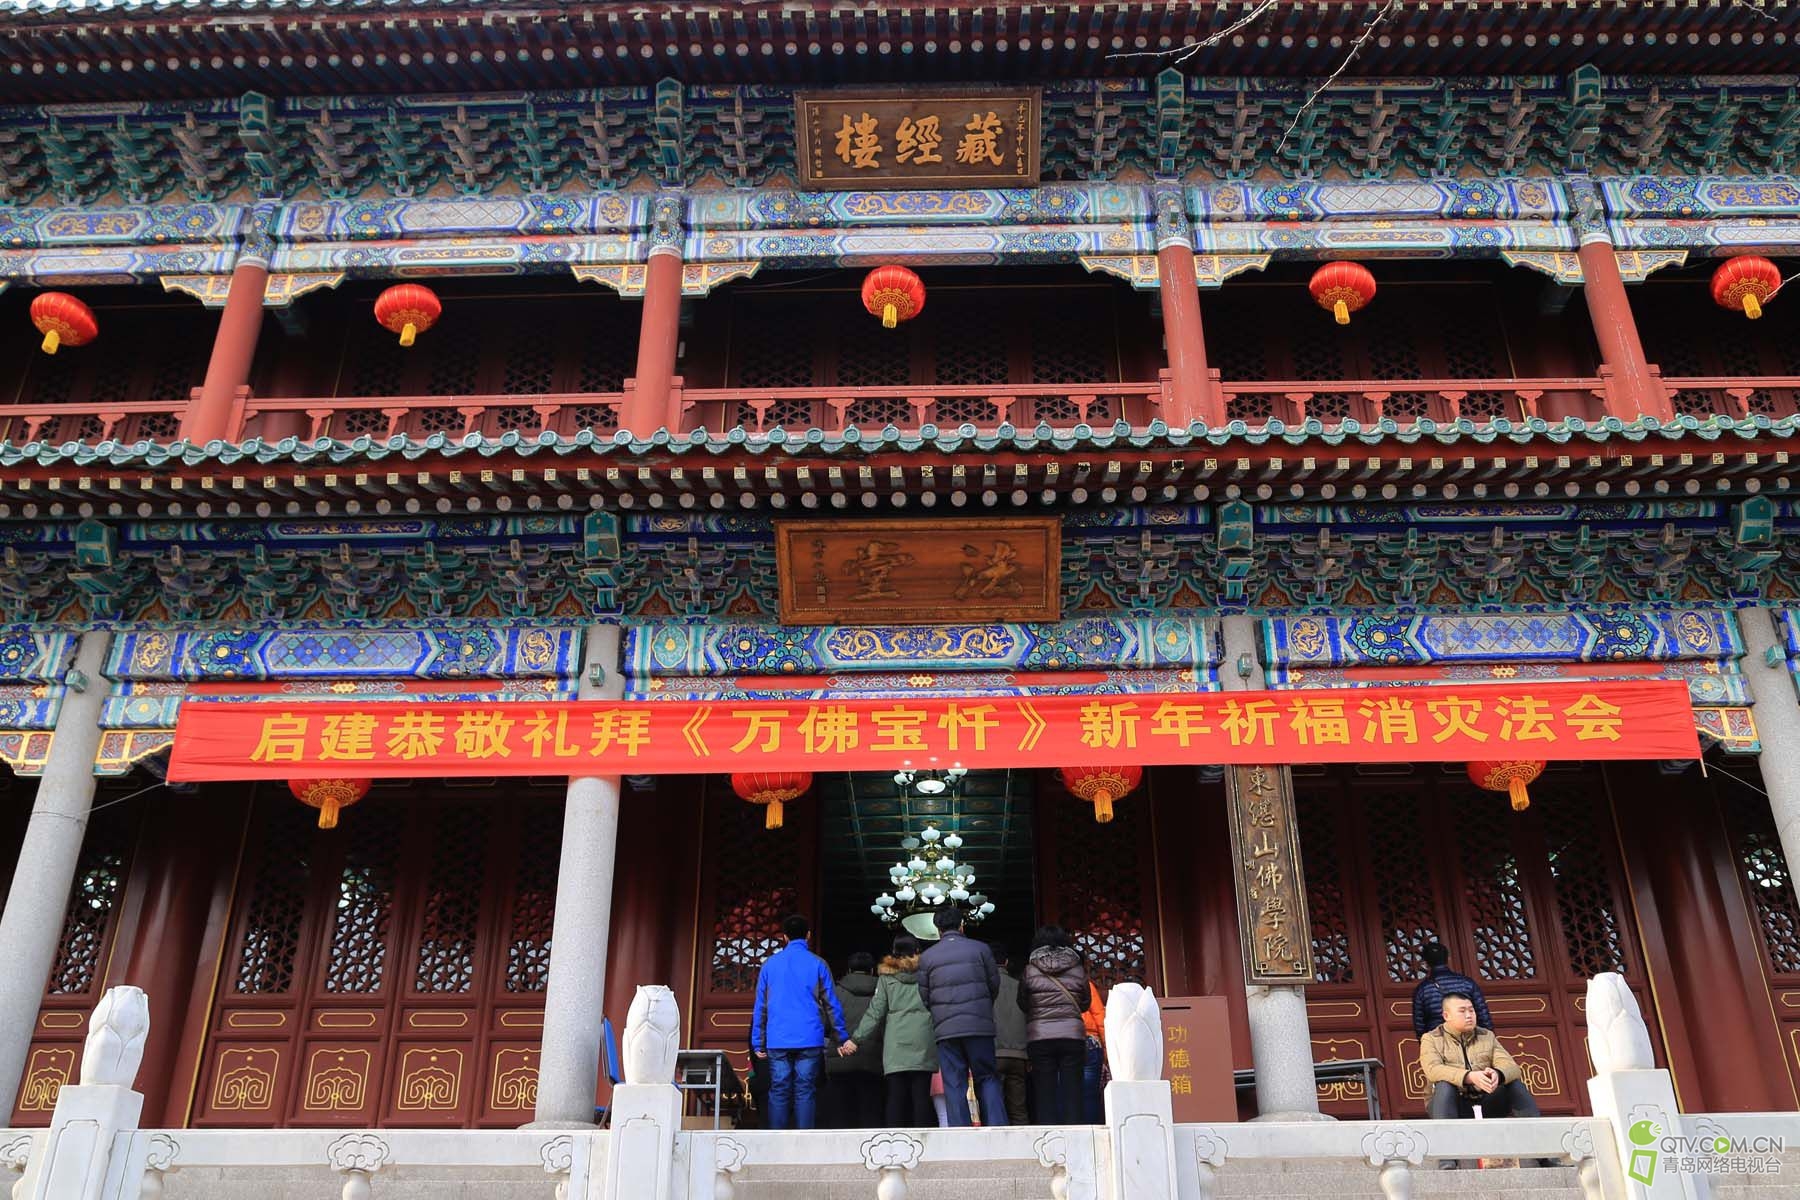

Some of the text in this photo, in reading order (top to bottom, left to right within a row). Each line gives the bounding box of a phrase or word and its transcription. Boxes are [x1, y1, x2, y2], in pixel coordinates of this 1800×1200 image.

[249, 694, 1623, 763] 启建恭敬礼拜《万佛宝忏》新年祈福消灾法会
[1167, 1025, 1192, 1095] 功德箱
